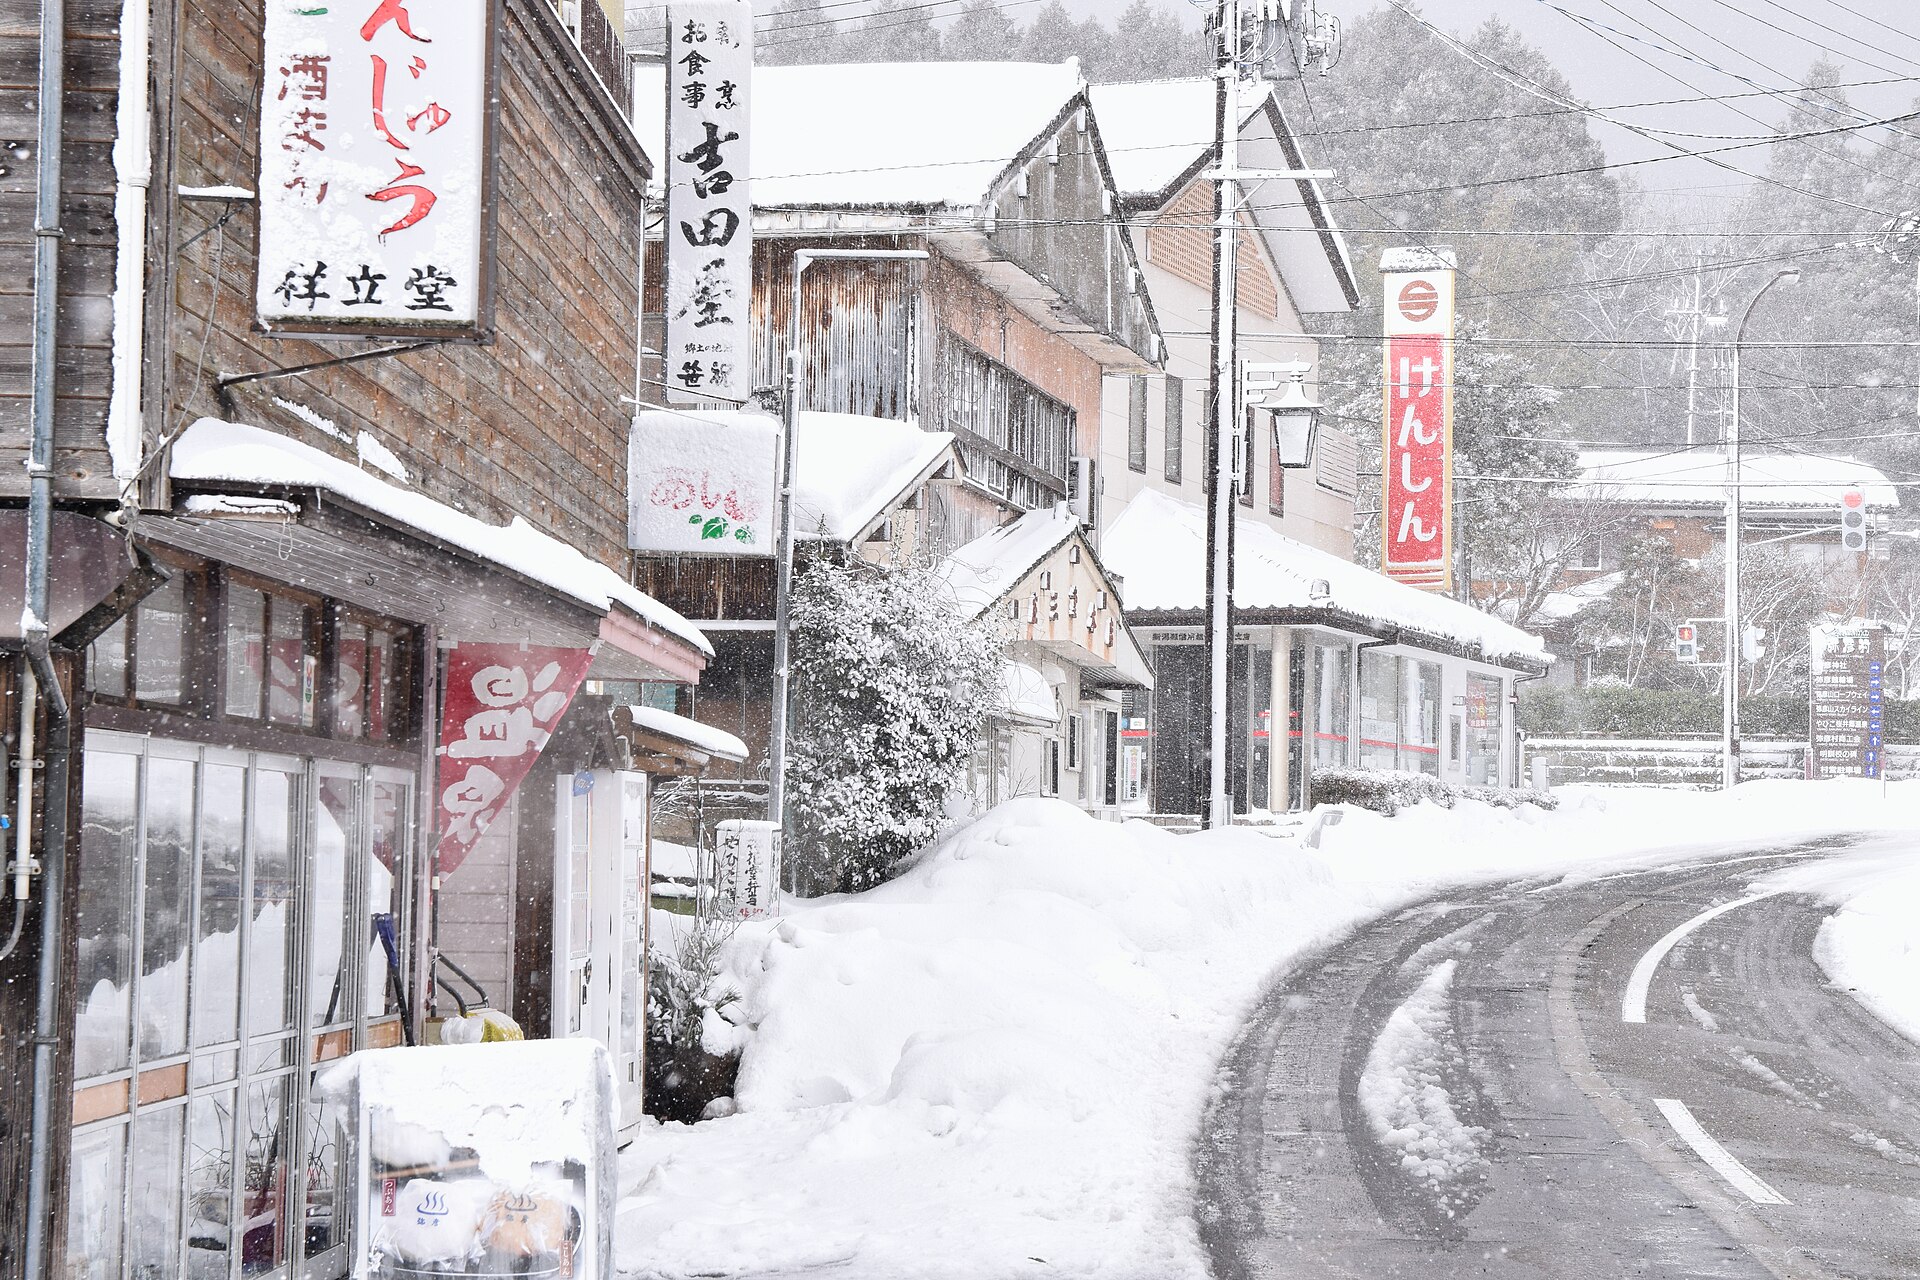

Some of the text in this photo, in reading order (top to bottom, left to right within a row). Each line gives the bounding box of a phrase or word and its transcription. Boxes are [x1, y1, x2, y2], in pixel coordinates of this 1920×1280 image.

[678, 19, 711, 109] お食事
[1398, 356, 1440, 542] けんしん
[1815, 691, 1868, 699] 弥彦山ロープウェイ
[1816, 705, 1869, 713] 弥彦山スカイライン
[384, 1181, 393, 1213] つぶあん
